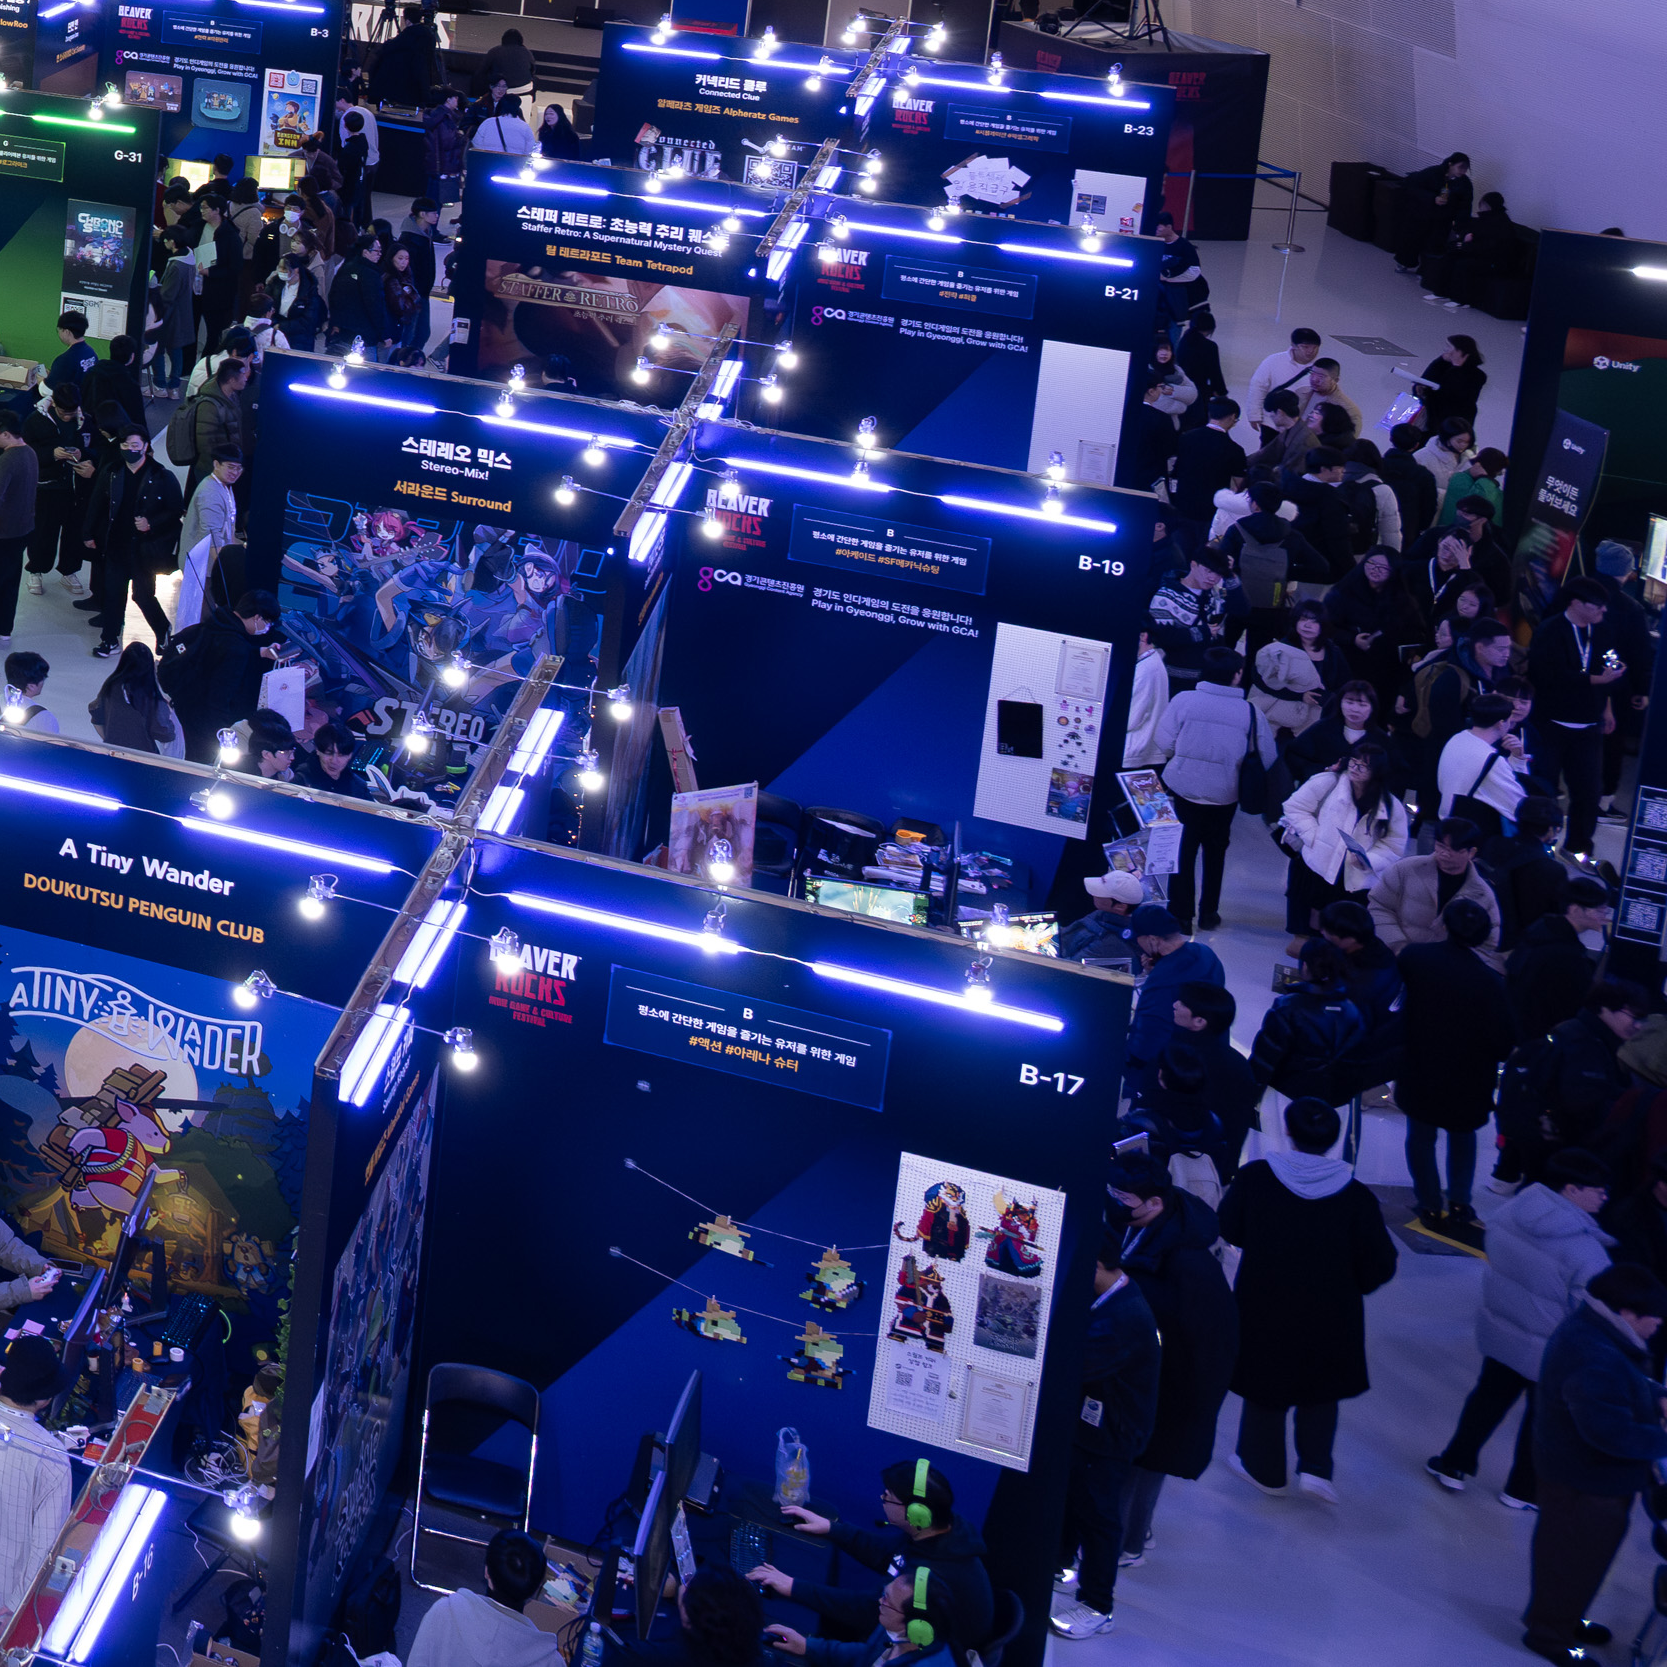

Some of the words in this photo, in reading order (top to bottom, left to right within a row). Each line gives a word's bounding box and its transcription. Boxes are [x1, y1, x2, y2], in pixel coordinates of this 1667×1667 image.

[310, 28, 329, 38] B-3
[699, 88, 740, 99] Connected
[742, 93, 760, 101] Clue
[1123, 123, 1154, 137] B-23
[114, 150, 142, 163] G-31
[517, 206, 558, 223] 스테퍼
[561, 212, 606, 229] 레트로:
[610, 218, 652, 237] 초능력
[656, 224, 683, 240] 추리
[522, 223, 553, 233] Staffer
[554, 226, 581, 237] Retro:
[583, 230, 590, 239] A
[592, 232, 652, 248] Supernatural
[654, 240, 692, 254] Mystery
[615, 256, 643, 267] Team
[646, 260, 693, 275] Tetrapod
[498, 280, 561, 301] STAFFER
[580, 291, 638, 312] RETRO
[1105, 285, 1138, 301] B-21
[1611, 359, 1640, 373] Unity
[401, 436, 471, 462] 스테레오
[477, 448, 512, 469] 믹스
[421, 460, 489, 480] Stereo-Mix!
[394, 480, 447, 500] 서라운드
[451, 492, 512, 512] Surround
[1077, 555, 1125, 577] B-19
[59, 838, 78, 860] A
[87, 844, 135, 875] Tiny
[141, 857, 235, 896] Wander
[23, 872, 123, 910] DOUKUTSU
[128, 897, 211, 931] PENGUIN
[216, 920, 265, 944] CLUB
[638, 1004, 669, 1021] 평소에
[671, 1013, 703, 1029] 간단한
[705, 1020, 737, 1037] 게임을
[740, 1030, 772, 1046] 즐기는
[775, 1038, 808, 1055] 유저를
[810, 1047, 832, 1060] 위한
[834, 1051, 856, 1067] 게임
[688, 1036, 722, 1053] #액션
[725, 1045, 771, 1065] #아레나
[774, 1056, 799, 1072] 슈터
[1019, 1063, 1084, 1096] B-17
